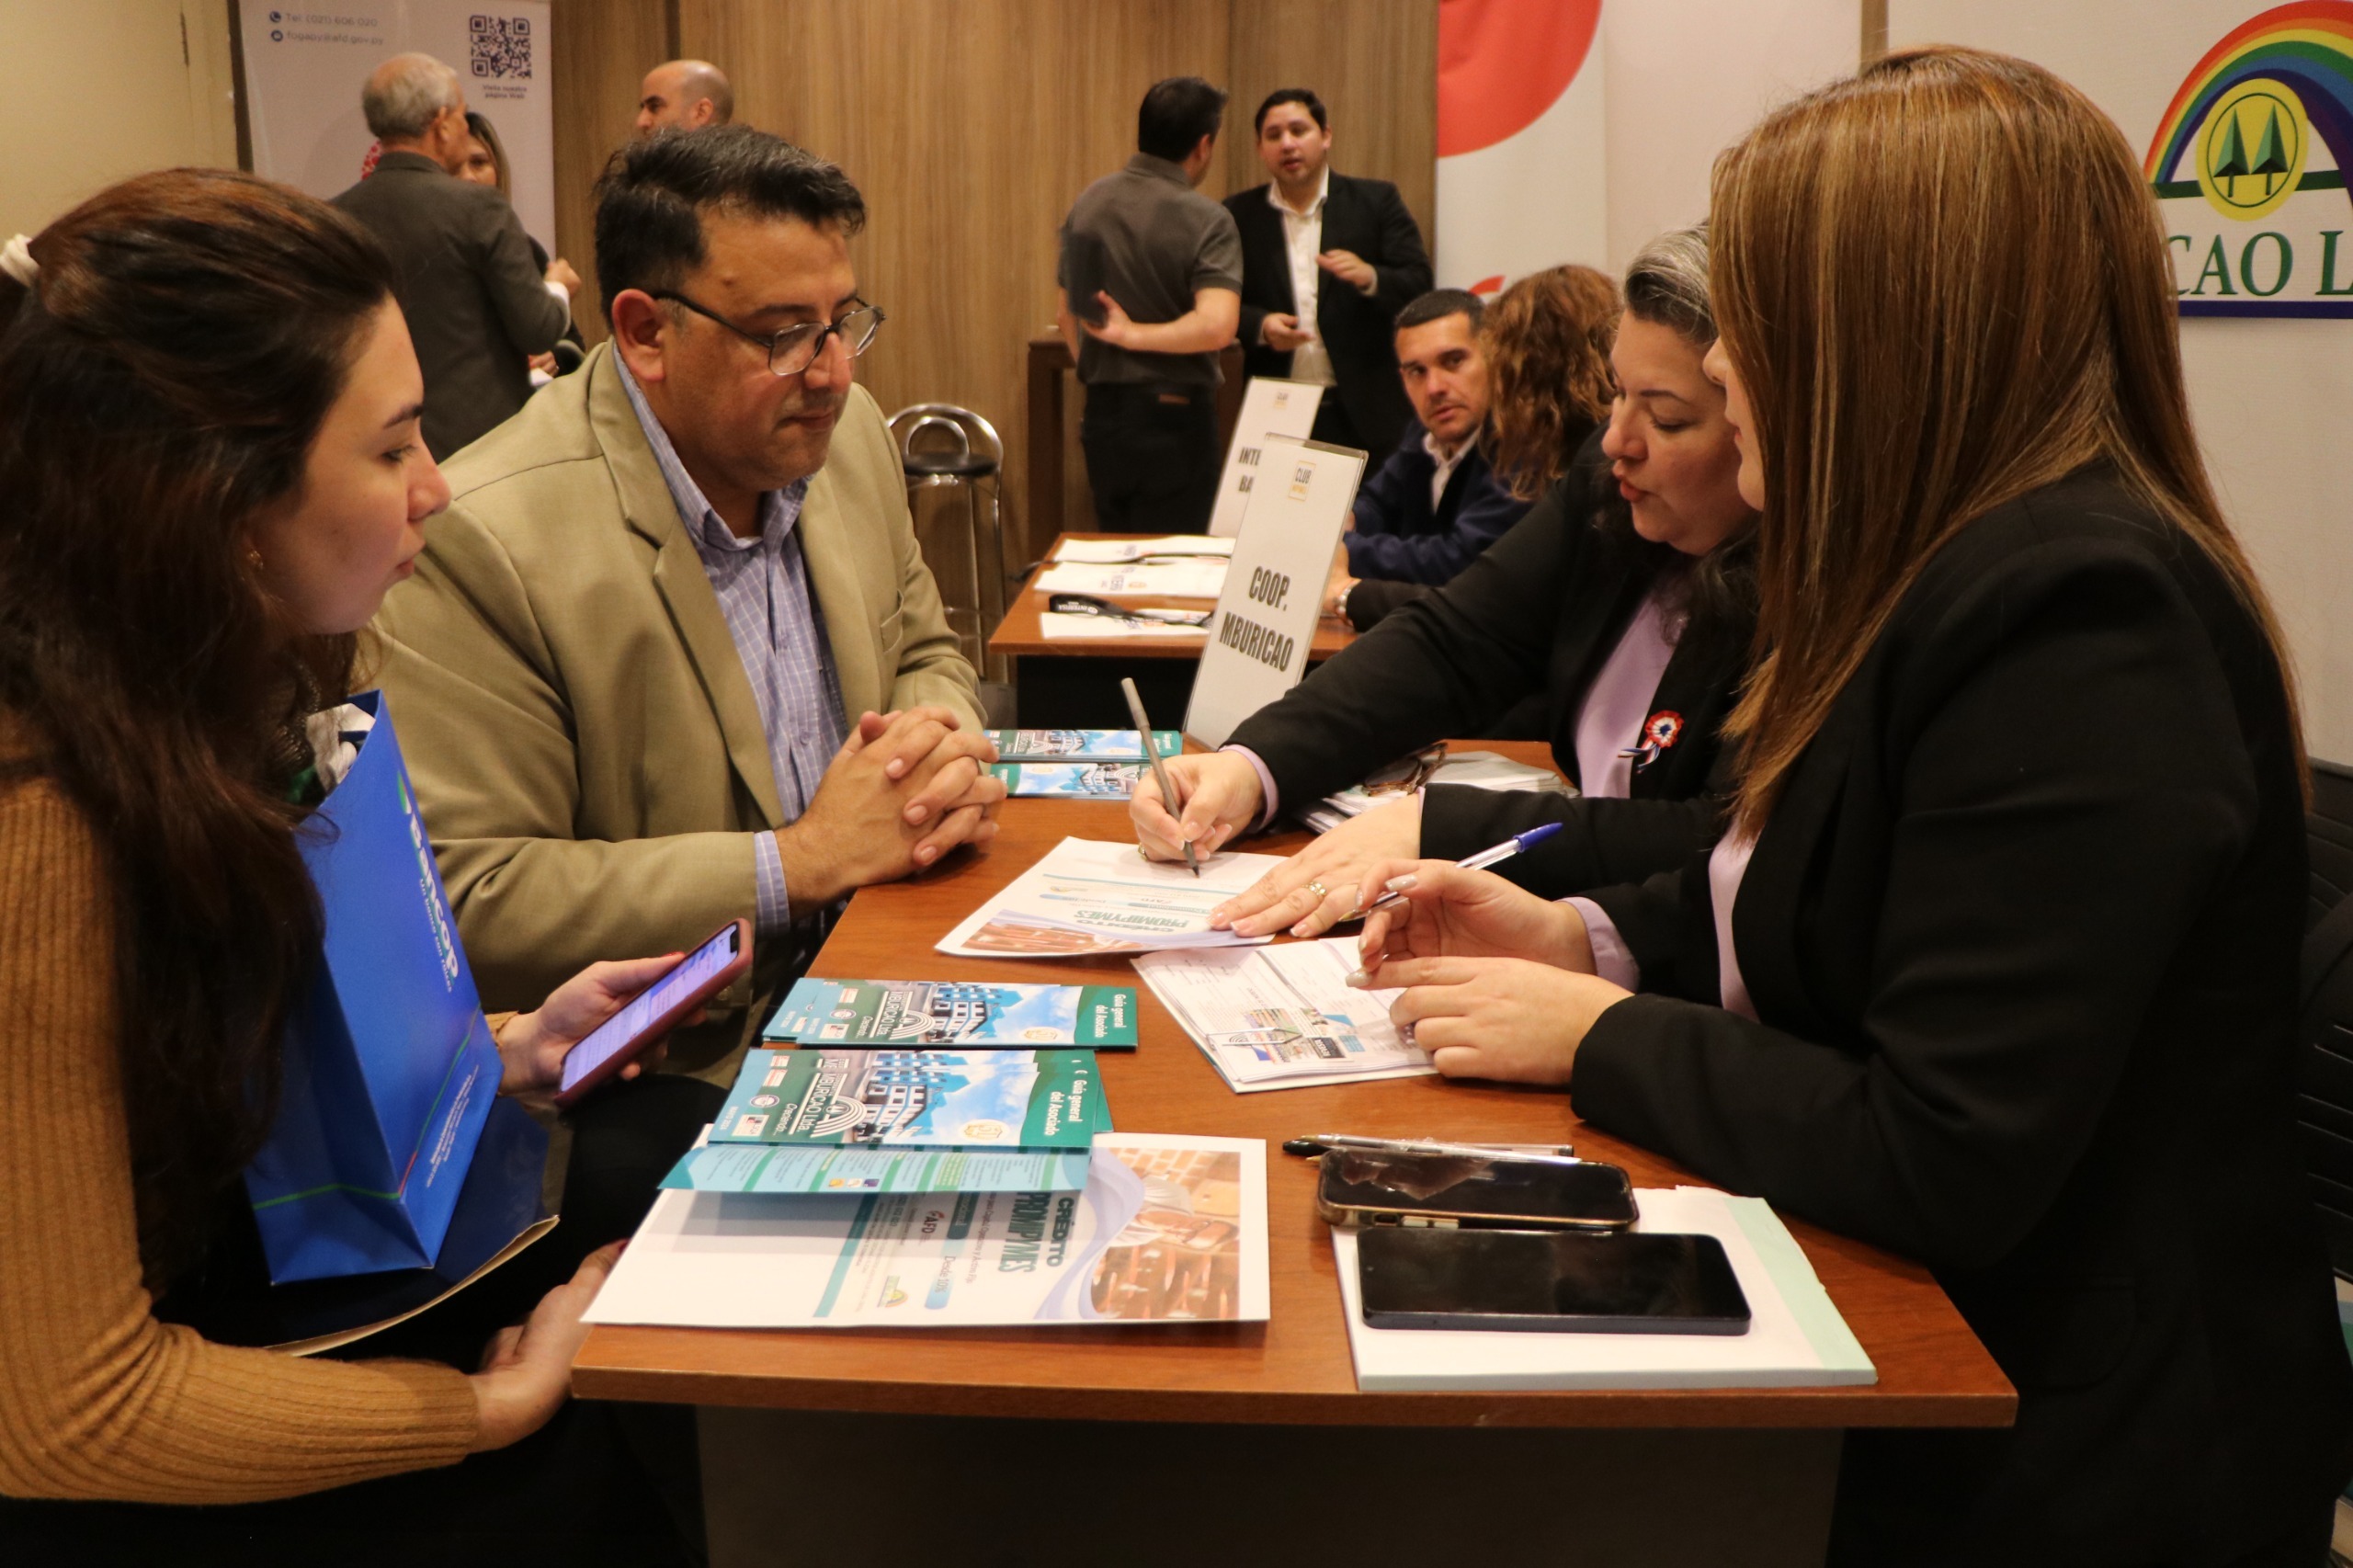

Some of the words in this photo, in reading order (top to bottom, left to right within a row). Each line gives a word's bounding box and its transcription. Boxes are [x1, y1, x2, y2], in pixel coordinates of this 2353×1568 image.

[358, 17, 378, 28] 020
[1295, 465, 1313, 486] CLUB
[1248, 565, 1290, 612] COOP.
[1219, 611, 1295, 673] MBURICAO
[410, 813, 459, 978] Bancop
[425, 898, 437, 935] banco
[435, 936, 444, 958] con
[1074, 910, 1191, 929] PROMIPYMES
[881, 992, 904, 1023] MBURICAO
[1095, 1004, 1108, 1017] del
[1113, 993, 1127, 1007] Guía
[1095, 1017, 1108, 1039] Asociado
[1110, 1007, 1127, 1028] general
[805, 1074, 828, 1113] MBURICAO
[1050, 1091, 1064, 1104] del
[1072, 1079, 1088, 1095] Guía
[1044, 1103, 1063, 1136] Asociado
[1068, 1095, 1085, 1123] general
[796, 1113, 813, 1133] Ltda.
[921, 1215, 939, 1234] AFD
[997, 1192, 1052, 1273] PROMIPYMES
[1046, 1197, 1075, 1267] CRÉDITO
[938, 1256, 957, 1278] Desde
